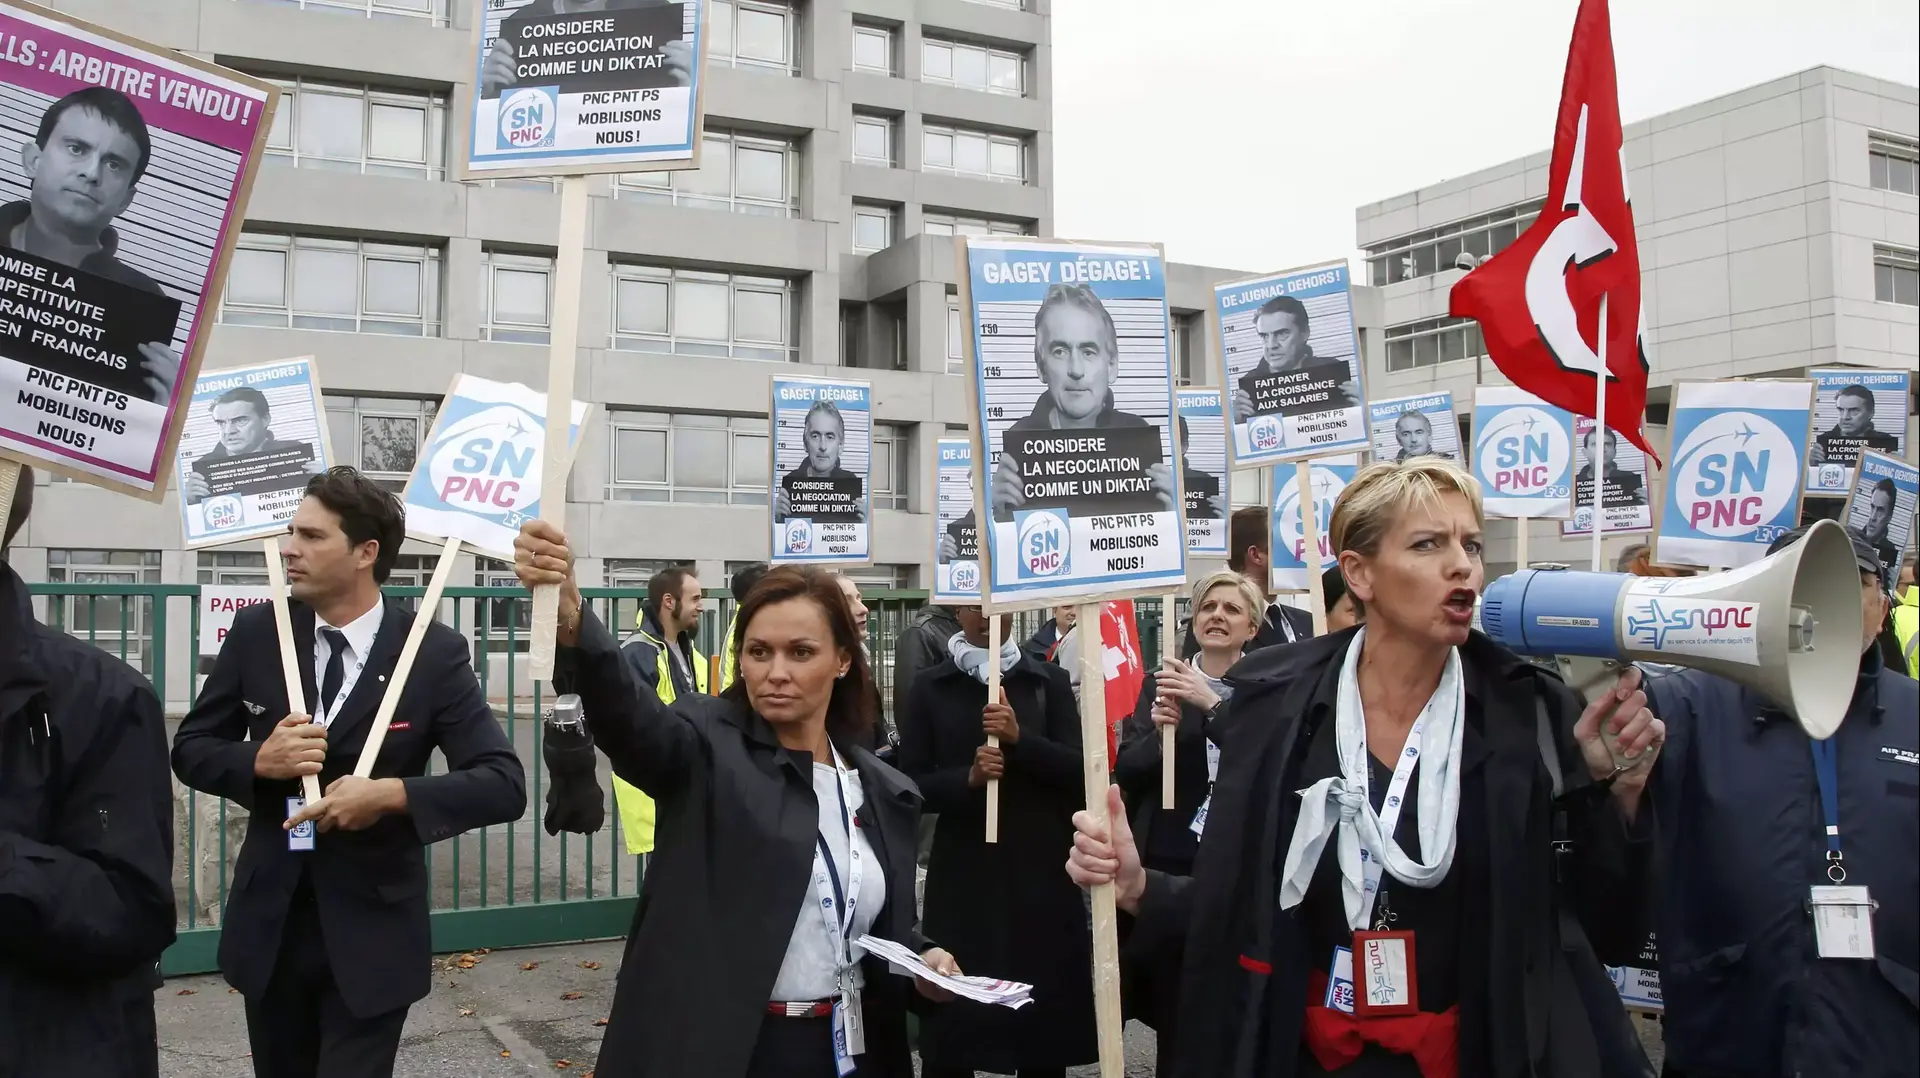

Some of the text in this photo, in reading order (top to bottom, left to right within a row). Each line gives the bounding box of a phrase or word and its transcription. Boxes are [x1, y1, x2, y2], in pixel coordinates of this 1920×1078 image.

[518, 35, 653, 59] LA NEGOCIATION
[49, 49, 156, 100] ARBITRE
[517, 54, 666, 78] COMME UN DIKTAT
[582, 89, 660, 106] PNC PNT PS
[510, 103, 544, 129] SN
[577, 109, 662, 126] MOBILISONS
[510, 126, 543, 145] PNC
[983, 261, 1051, 284] GAGEY
[51, 272, 76, 292] LA
[1223, 295, 1238, 309] DE
[1239, 285, 1285, 305] JUGNAC
[0, 298, 106, 342] RANSPORT
[31, 329, 128, 371] FRANCAIS
[26, 367, 129, 411] PNC PNT PS
[1255, 372, 1310, 389] FAIT PAYER
[1827, 376, 1861, 385] JUGNAC
[781, 388, 816, 401] GAGEY
[1256, 380, 1336, 400] LA CROISSANCE
[1257, 392, 1330, 411] AUX SALARIES
[1372, 404, 1403, 417] GAGEY
[17, 389, 127, 436] MOBILISONS
[1298, 409, 1345, 422] PNC PNT PS
[1256, 423, 1276, 440] SN
[1297, 420, 1348, 434] MOBILISONS
[1257, 437, 1278, 449] PNC
[1496, 432, 1549, 468] SN
[452, 437, 536, 479] SN
[943, 449, 956, 460] DE
[1023, 457, 1140, 476] LA NEGOCIATION
[1695, 449, 1771, 498] SN
[1825, 470, 1839, 480] SN
[1024, 477, 1152, 498] COMME UN DIKTAT
[1495, 466, 1548, 492] PNC
[258, 490, 278, 501] PNC
[278, 489, 295, 499] PNT
[439, 476, 520, 508] PNC
[791, 493, 851, 502] LA NEGOCIATION
[212, 503, 235, 520] SN
[791, 504, 856, 513] COMME UN DIKTAT
[1690, 497, 1763, 530] PNC
[213, 515, 236, 528] PNC
[1091, 514, 1154, 531] PNC PNT PS
[792, 529, 807, 543] SN
[821, 534, 857, 542] MOBILISONS
[961, 538, 972, 546] LA
[1031, 528, 1059, 553] SN
[1090, 534, 1159, 552] MOBILISONS
[791, 541, 807, 551] PNC
[1031, 552, 1060, 573] PNC
[957, 570, 974, 581] SN
[957, 581, 974, 591] PNC
